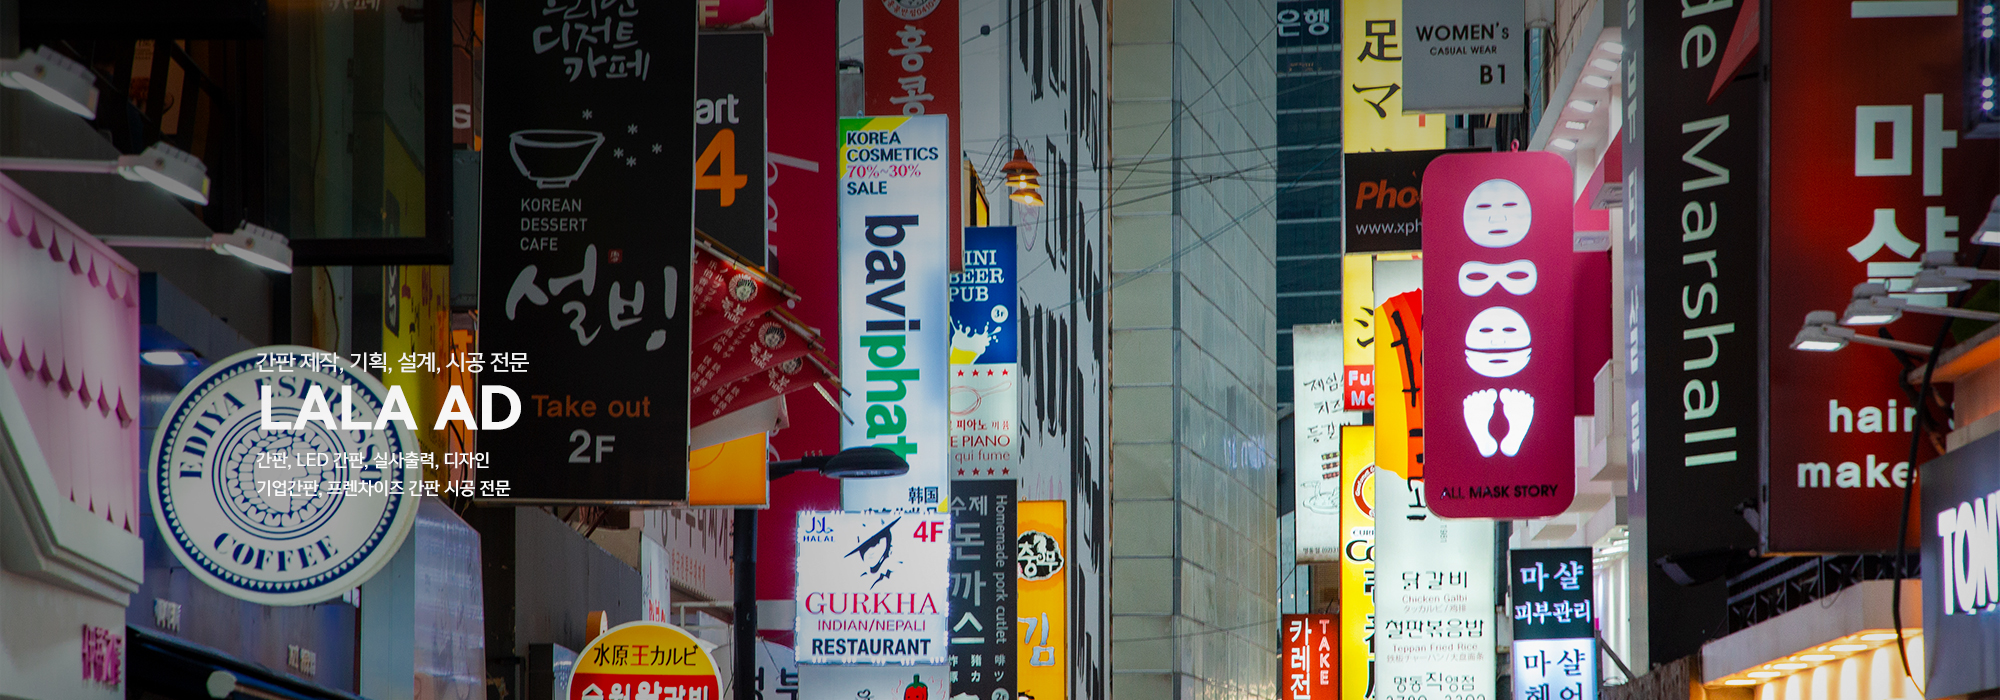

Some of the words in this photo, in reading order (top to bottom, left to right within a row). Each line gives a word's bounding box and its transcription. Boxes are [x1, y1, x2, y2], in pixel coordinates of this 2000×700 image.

[1277, 8, 1330, 37] 은행
[1416, 22, 1509, 42] WOMEN's
[533, 16, 639, 54] 디저트
[1430, 46, 1467, 56] CASUAL
[1471, 46, 1497, 55] WEAR
[563, 46, 650, 82] 카페
[887, 24, 934, 116] 홍콩
[1480, 64, 1506, 84] B1
[847, 131, 901, 146] KOREA
[847, 147, 939, 162] COSMETICS
[695, 128, 748, 207] 4
[847, 164, 921, 179] 70%~30%
[847, 181, 888, 195] SALE
[1355, 179, 1421, 210] Pho
[521, 198, 582, 212] KOREAN
[521, 218, 587, 232] DESSERT
[521, 238, 558, 251] CAFE
[964, 250, 997, 266] INI
[505, 244, 678, 351] 설빙
[950, 286, 989, 302] PUB
[1681, 114, 1737, 467] Marshall
[532, 395, 598, 418] Take
[608, 396, 651, 418] out
[1829, 399, 1917, 433] hair
[179, 392, 246, 479] EDIYA
[957, 419, 987, 431] 피아노
[568, 429, 616, 463] 2F
[951, 436, 958, 447] E
[962, 435, 1010, 447] PIANO
[955, 450, 974, 464] qui
[978, 449, 1010, 461] fume
[1797, 454, 1918, 489] make
[908, 486, 939, 504] 韩国
[1441, 486, 1465, 499] ALL
[1469, 485, 1510, 498] MASK
[1514, 484, 1558, 497] STORY
[951, 495, 988, 516] 수제
[803, 535, 834, 543] HALAL
[913, 521, 944, 543] 4F
[995, 495, 1008, 567] Homemade
[214, 533, 338, 572] COFFEE
[951, 522, 987, 644] 돈까스
[993, 572, 1008, 602] pork
[1402, 571, 1467, 591] 닭갈비
[805, 591, 940, 615] GURKHA
[1402, 594, 1440, 604] Chicken
[1443, 594, 1468, 603] Galbi
[1515, 599, 1590, 626] 피부관리
[818, 618, 926, 632] INDIAN/NEPALI
[996, 605, 1008, 644] cutlet
[1385, 618, 1484, 639] 철판볶음밥
[594, 643, 699, 666] 水原王カルビ
[812, 638, 931, 656] RESTAURANT
[1318, 619, 1330, 685] TAKE
[1394, 644, 1427, 654] Teppan
[1430, 643, 1454, 652] Fried
[1457, 643, 1478, 651] Rice
[1289, 617, 1312, 700] 카레전
